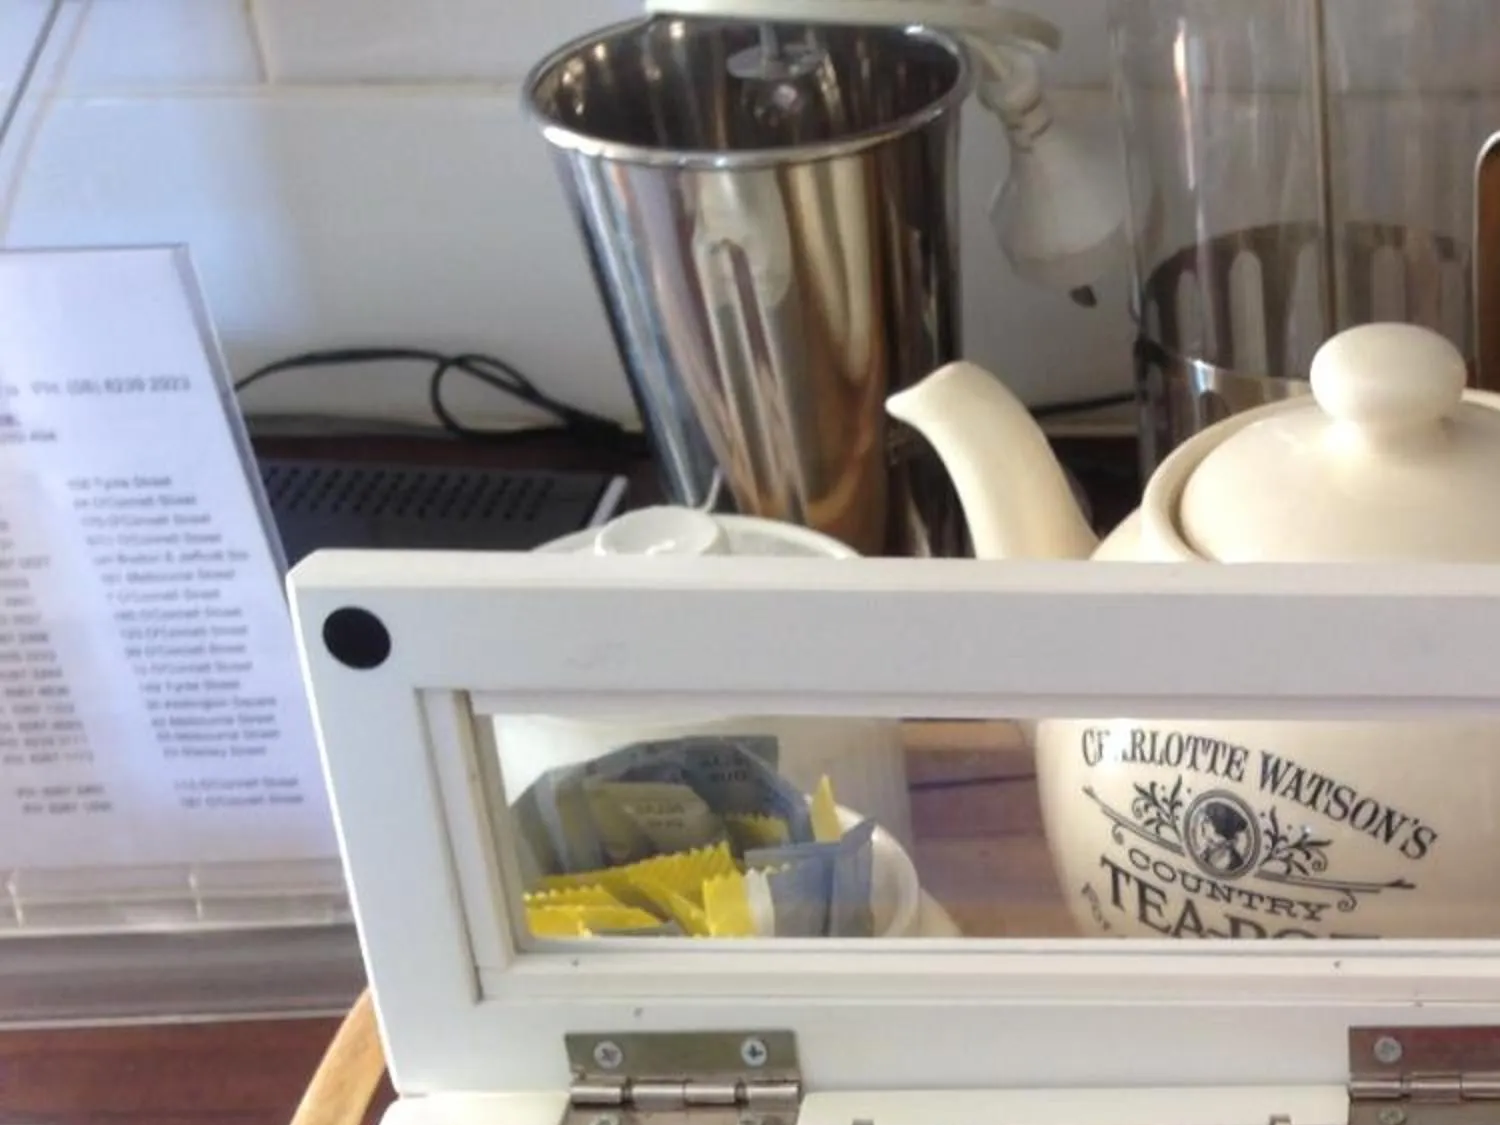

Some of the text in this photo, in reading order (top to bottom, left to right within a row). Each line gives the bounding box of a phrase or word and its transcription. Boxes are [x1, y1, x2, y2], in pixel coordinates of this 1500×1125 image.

[1081, 726, 1438, 862] CRLOTTE WATSON'S
[1100, 853, 1382, 939] TEA-P
[1128, 847, 1332, 922] COUNTRY
